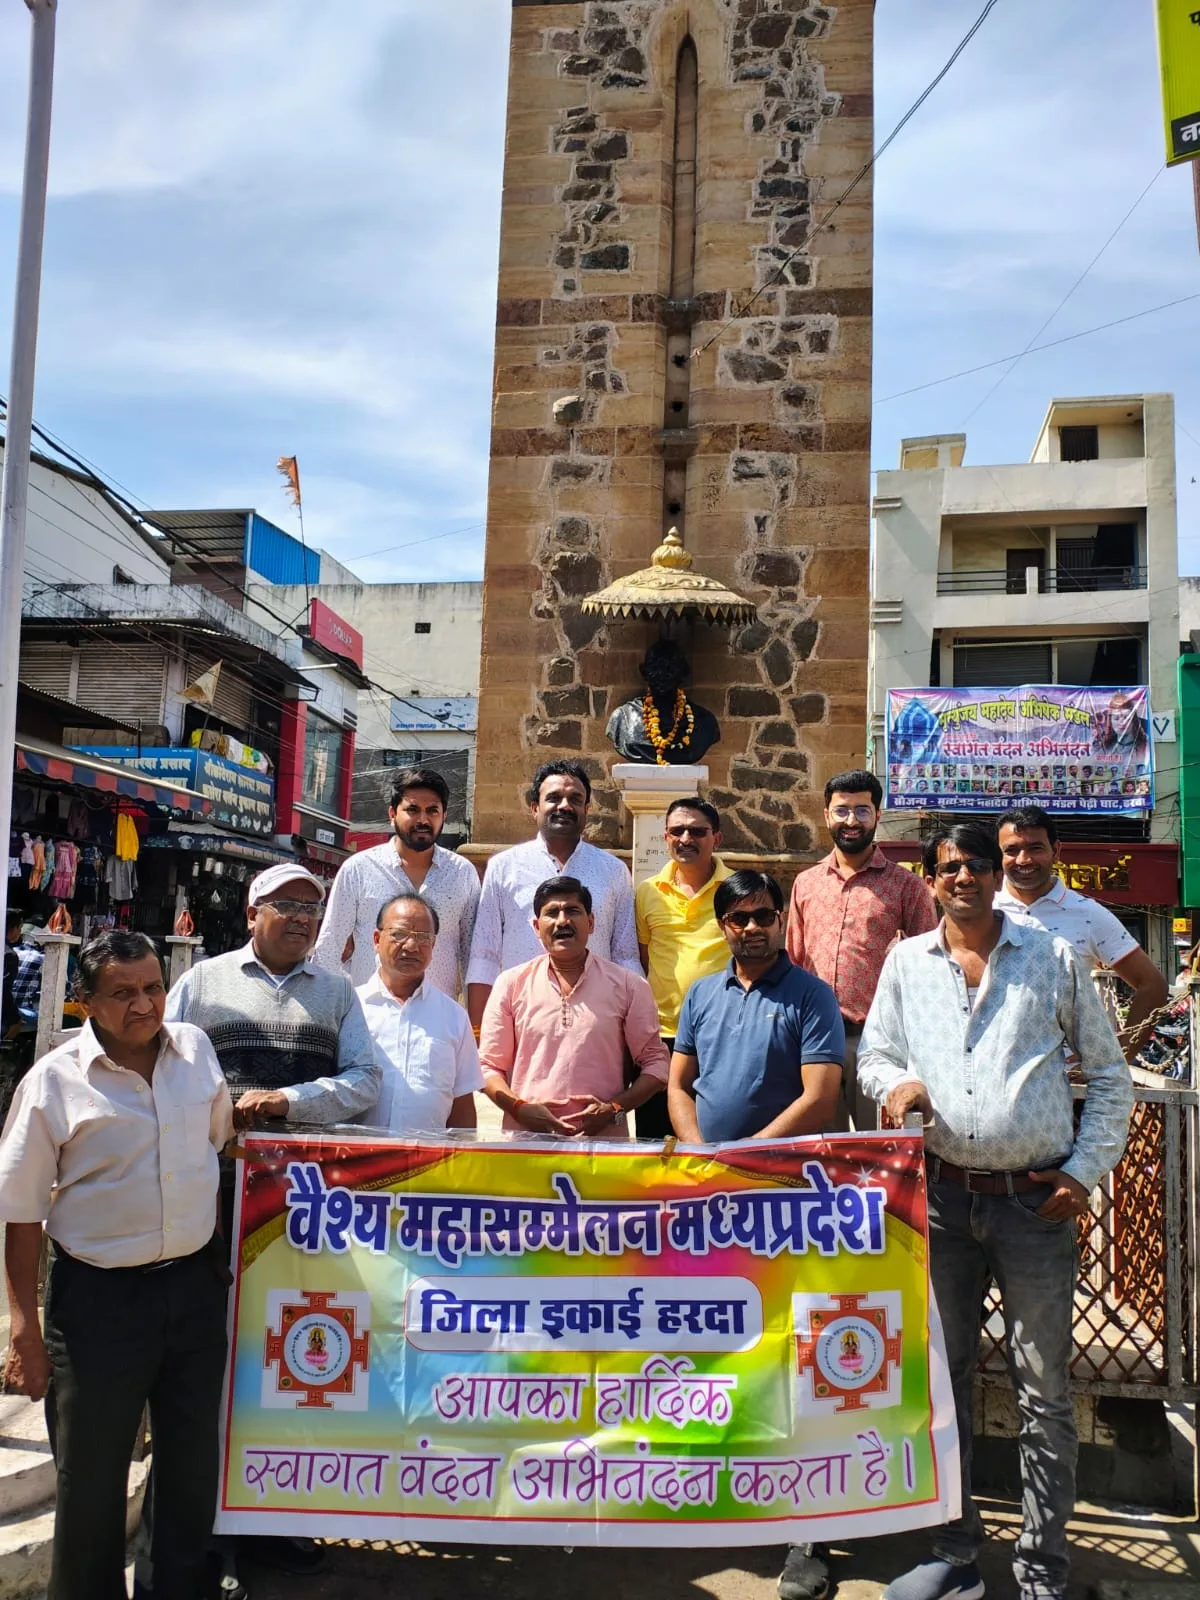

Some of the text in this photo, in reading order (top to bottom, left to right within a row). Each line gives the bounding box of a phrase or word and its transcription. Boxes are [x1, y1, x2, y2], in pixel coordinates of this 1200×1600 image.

[980, 695, 1016, 723] महादेव
[1020, 695, 1060, 721] अभिषेक
[1063, 702, 1091, 728] मंडल
[943, 736, 1091, 759] स्वागत वंदन अभिनंदन
[287, 1163, 885, 1266] वैश्य महासम्मेलन मध्यप्रदेश
[419, 1288, 747, 1339] जिला इकाई हरदा
[434, 1358, 735, 1424] आपका हार्दिक
[245, 1450, 390, 1495] स्वागत
[400, 1439, 502, 1501] वंदन
[512, 1437, 721, 1506] अभिनंदन
[733, 1453, 852, 1504] करता
